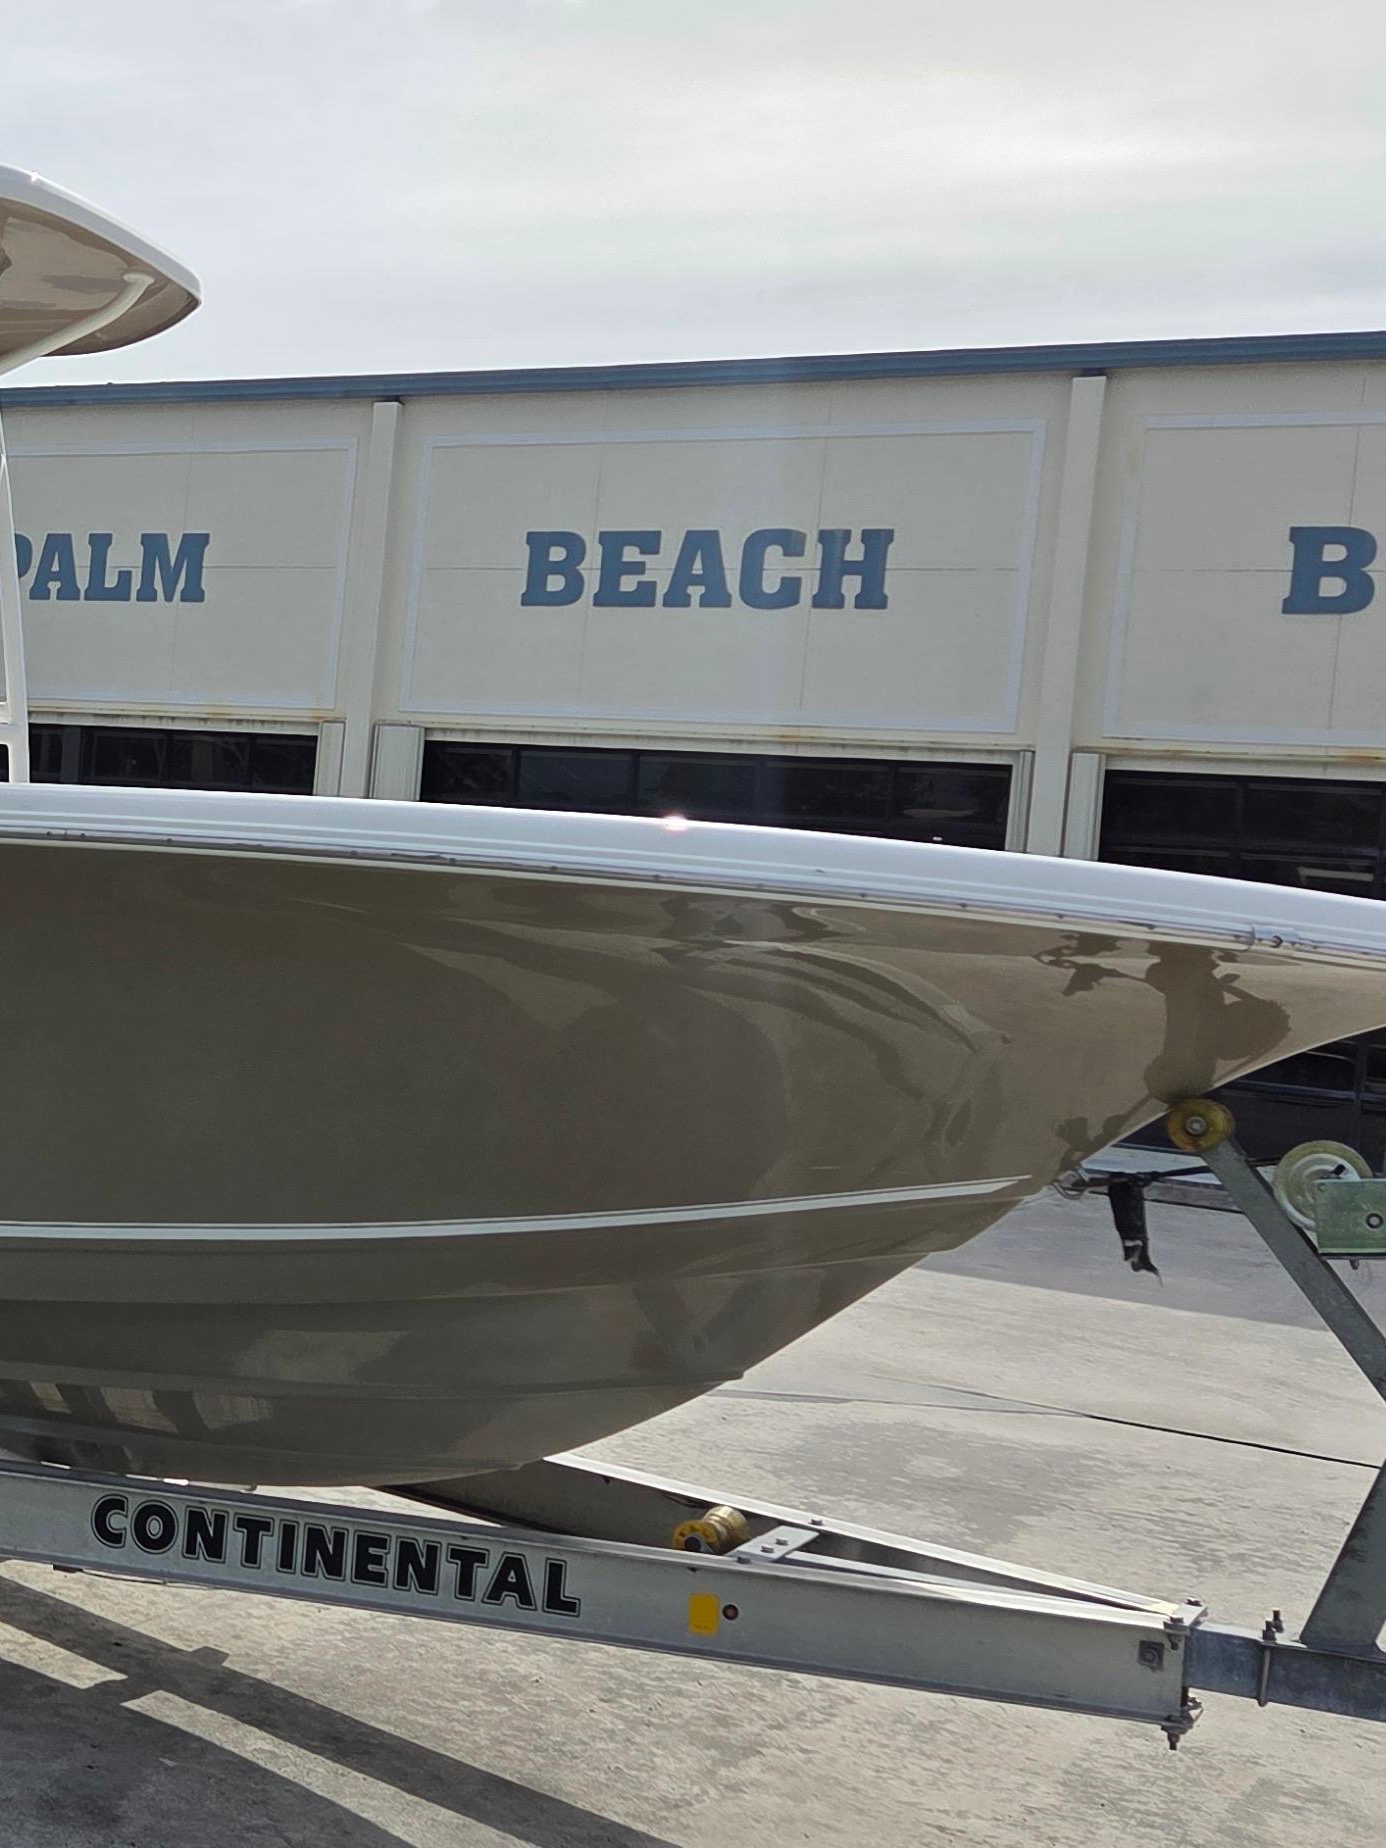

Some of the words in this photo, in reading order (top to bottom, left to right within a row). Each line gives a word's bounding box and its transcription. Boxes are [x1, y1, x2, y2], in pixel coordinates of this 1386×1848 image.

[521, 528, 894, 609] BEACH
[1281, 526, 1378, 614] B
[91, 1494, 581, 1618] CONTINENTAL
